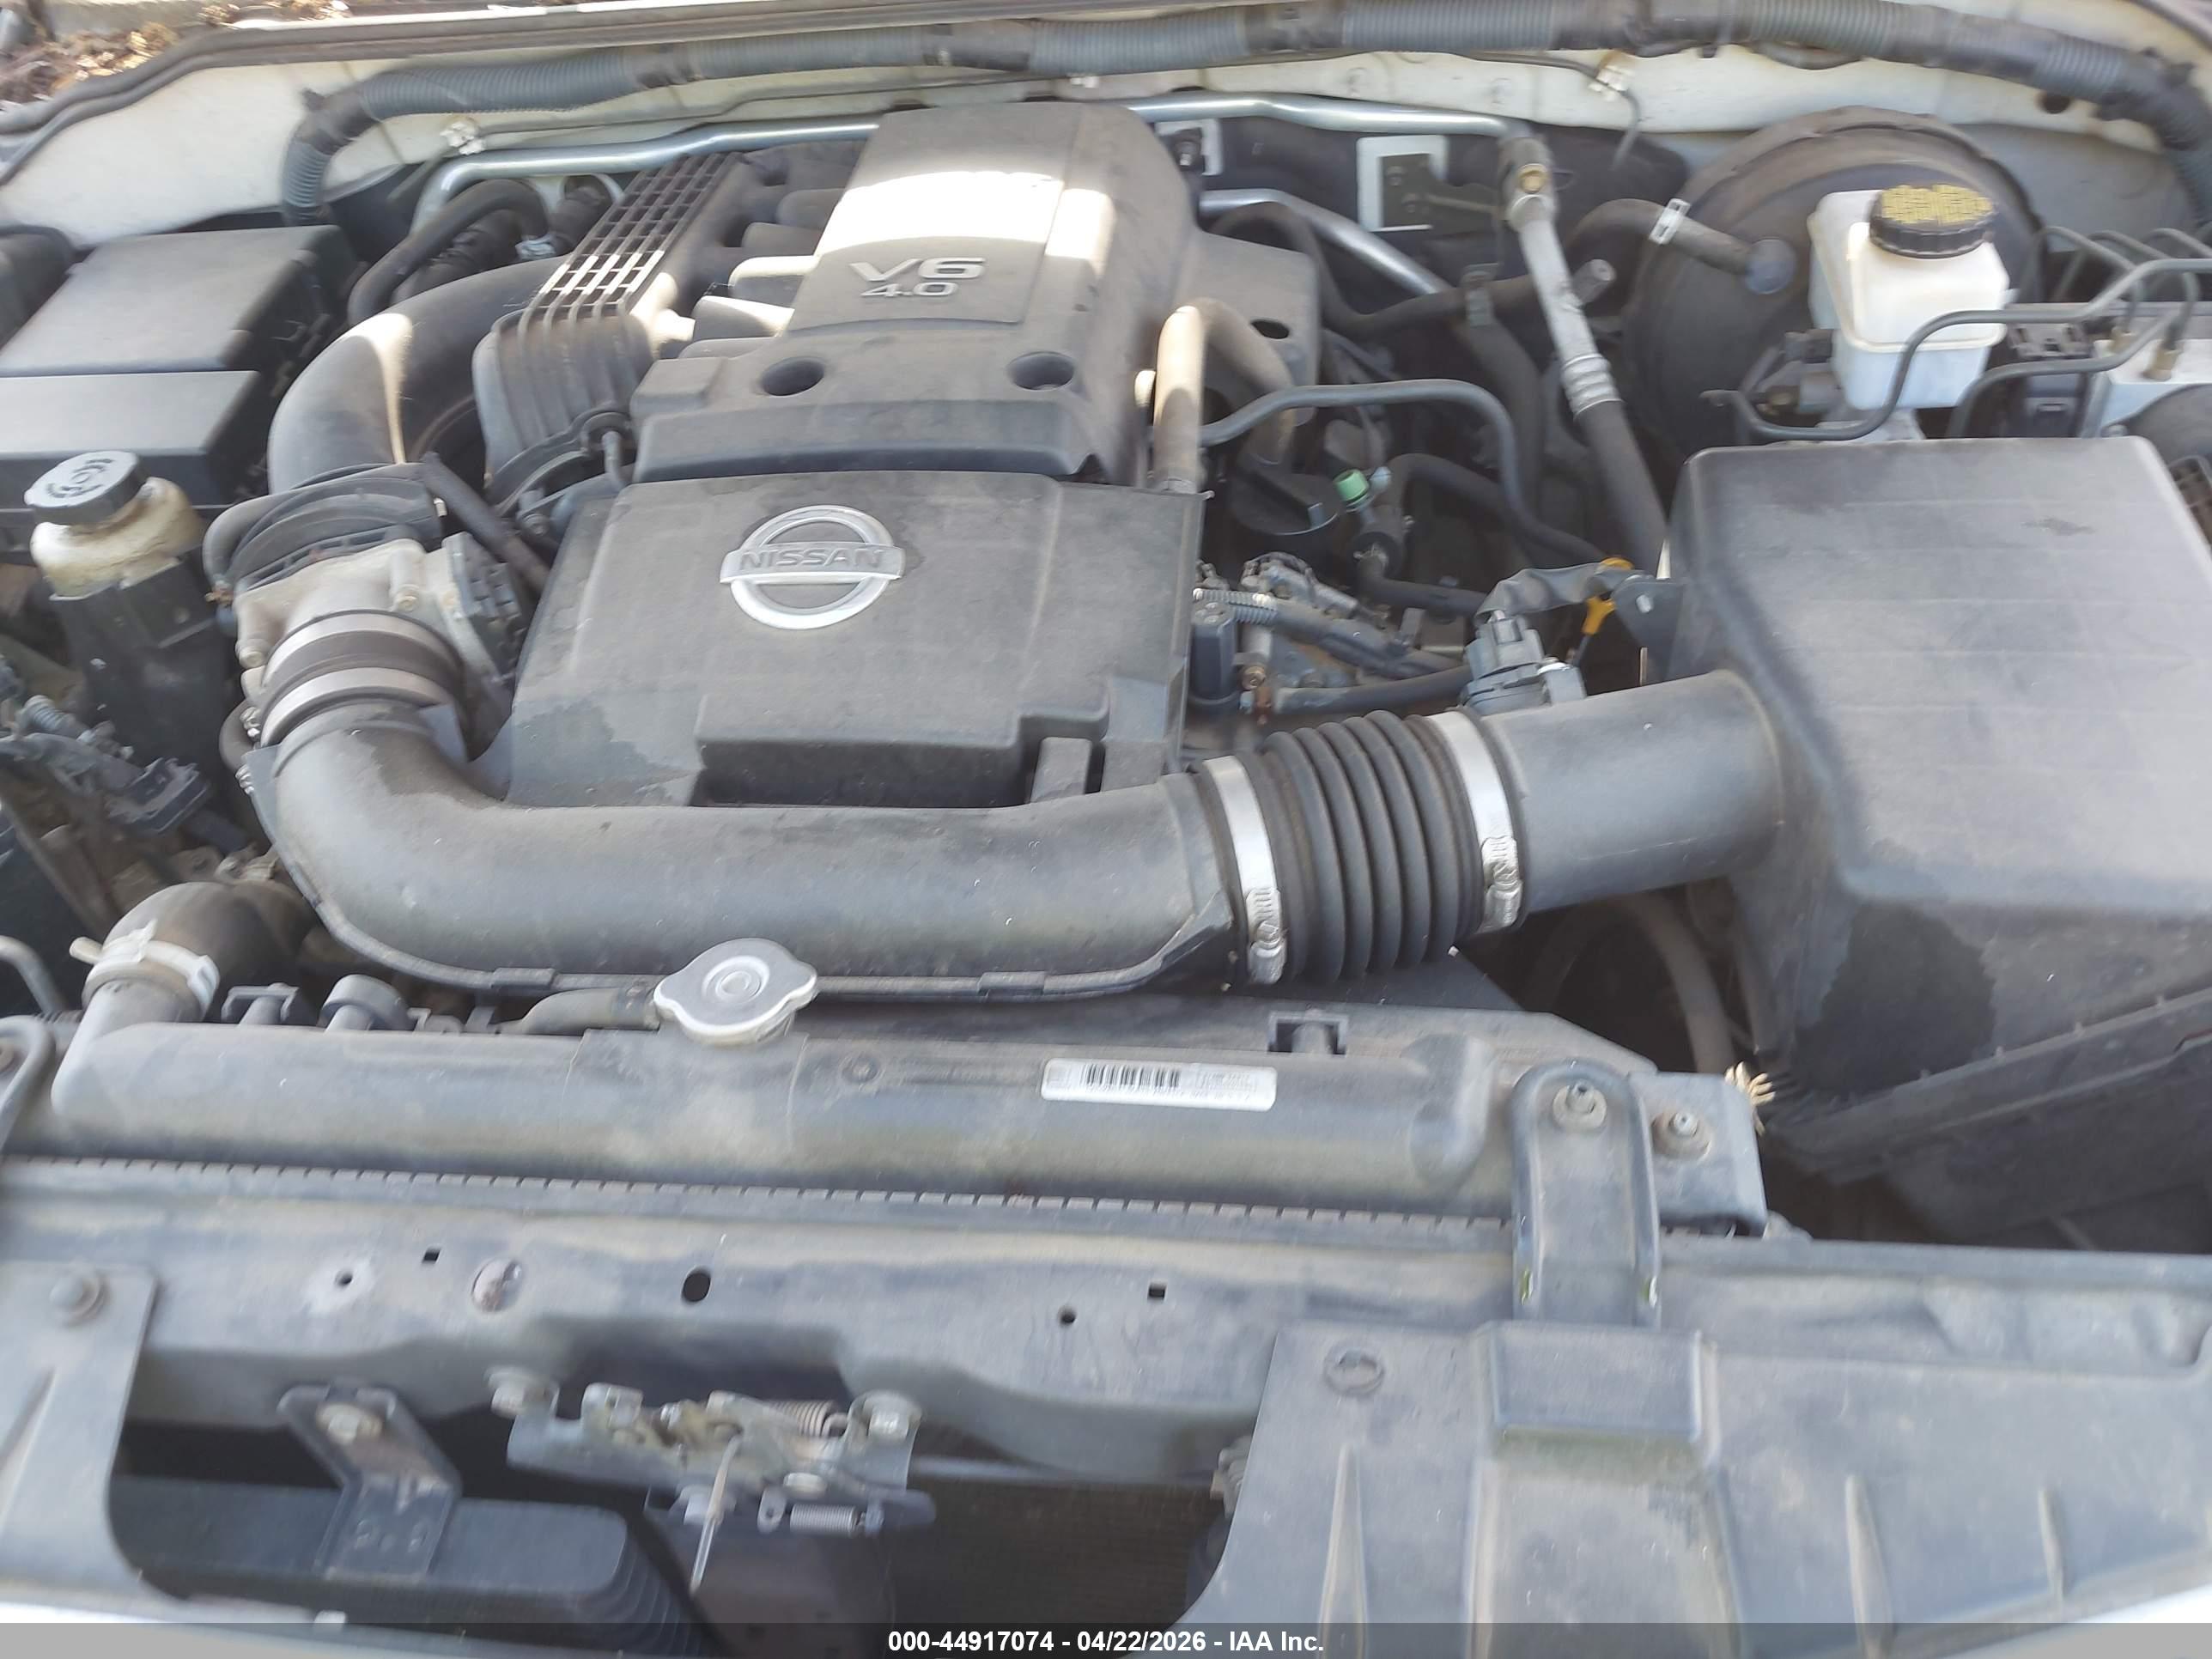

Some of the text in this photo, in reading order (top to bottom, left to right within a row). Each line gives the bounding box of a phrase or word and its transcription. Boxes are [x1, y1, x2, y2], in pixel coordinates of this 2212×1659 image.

[850, 258, 986, 282] V6
[860, 282, 960, 298] 4.0
[740, 549, 884, 570] NISSAN
